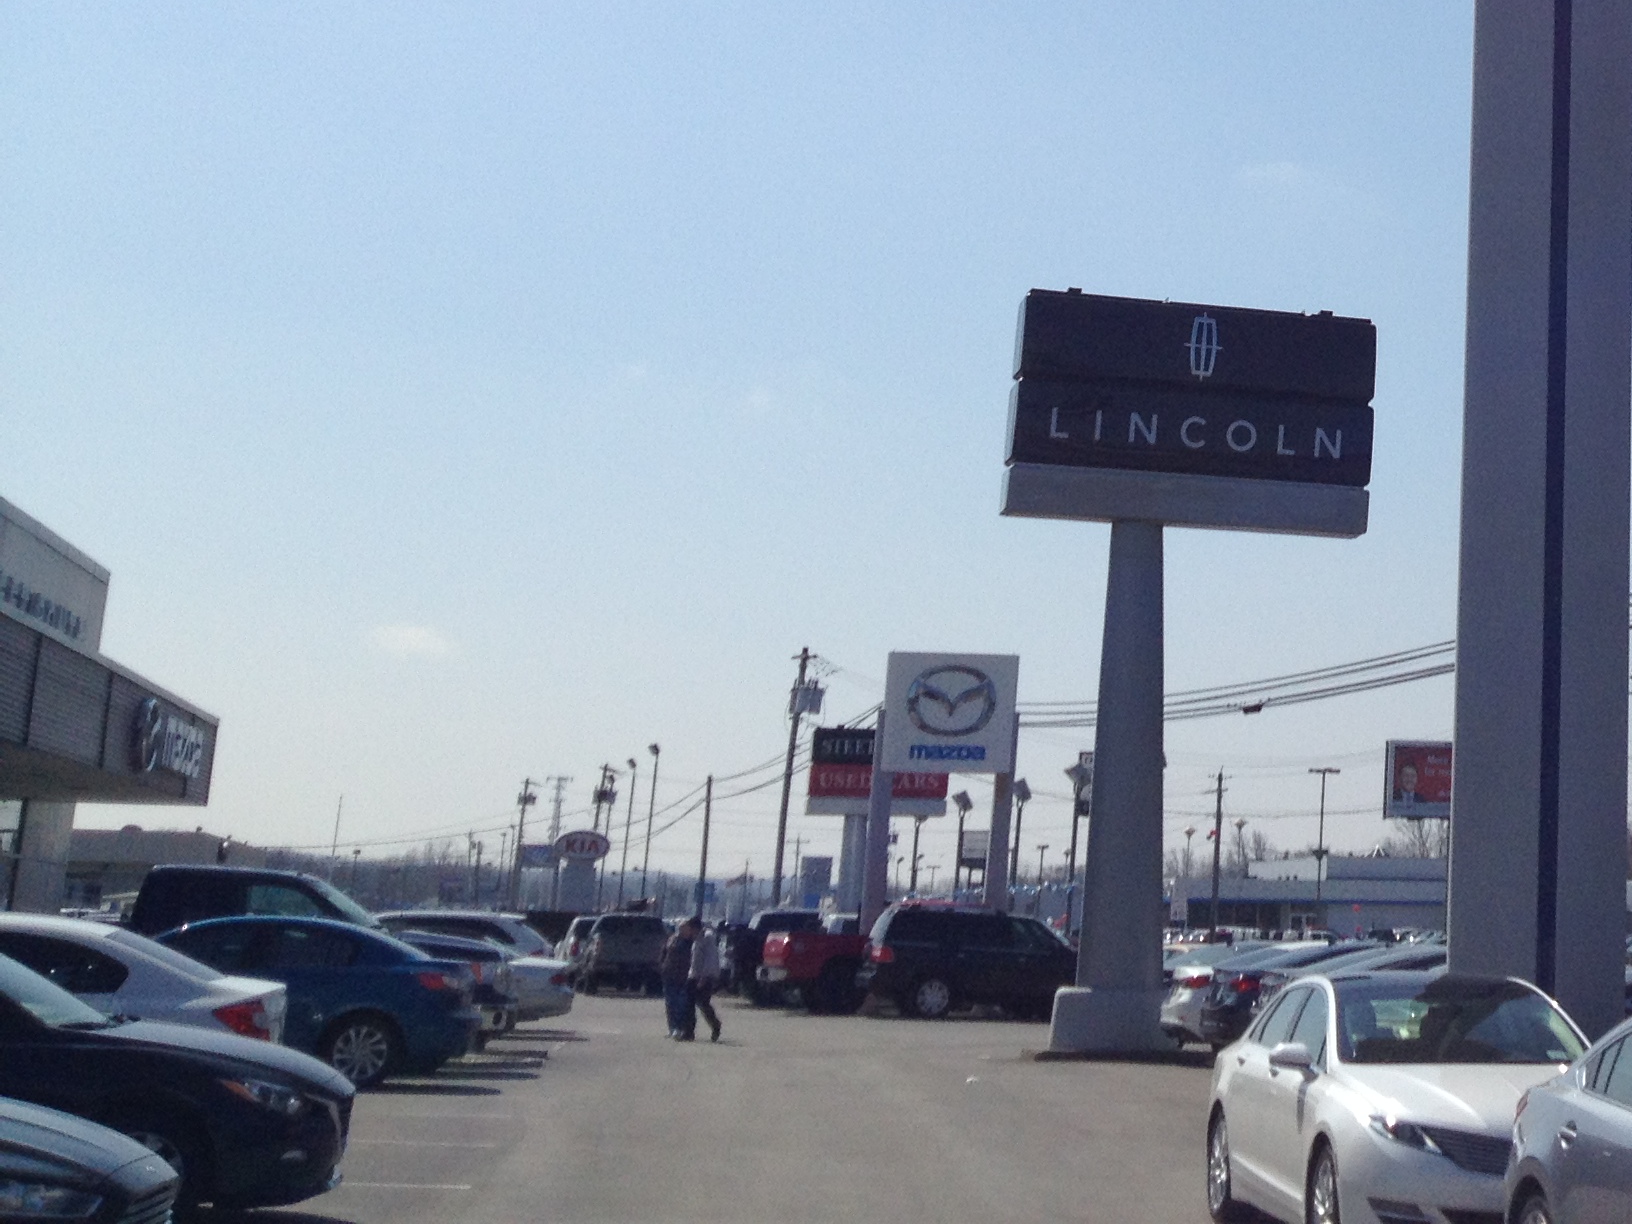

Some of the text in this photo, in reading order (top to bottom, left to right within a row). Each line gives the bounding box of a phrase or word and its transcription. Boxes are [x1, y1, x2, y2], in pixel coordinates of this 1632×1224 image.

[1049, 406, 1343, 460] LINCOLN
[162, 715, 204, 778] mazda
[909, 744, 986, 760] mazda
[897, 774, 941, 790] ARS
[565, 838, 599, 854] KIA
